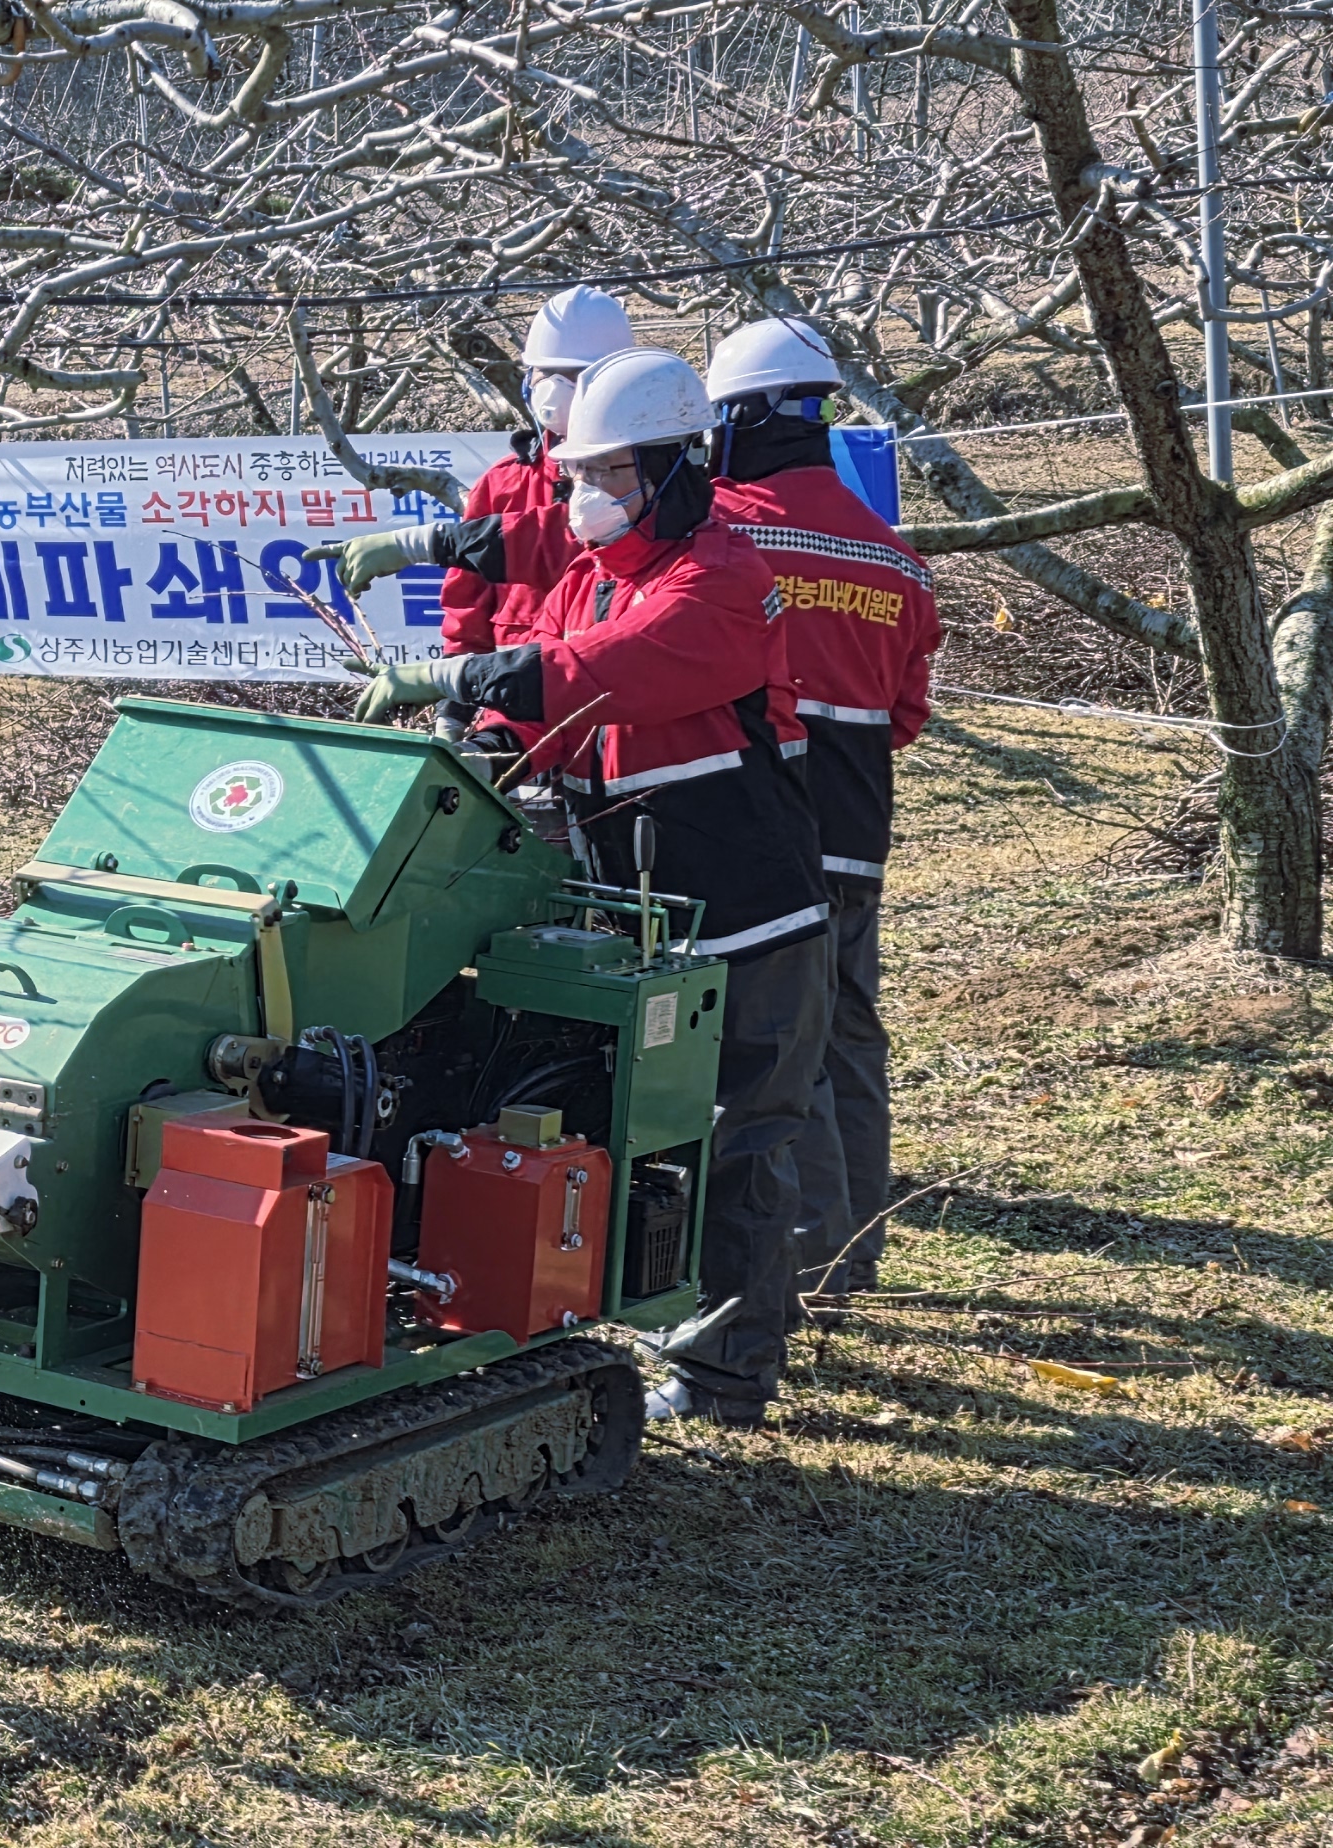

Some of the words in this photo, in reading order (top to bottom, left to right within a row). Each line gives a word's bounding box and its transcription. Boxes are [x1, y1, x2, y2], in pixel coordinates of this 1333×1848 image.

[66, 457, 149, 482] 저력있는
[155, 452, 243, 482] 역사도시
[250, 450, 344, 481] 중흥하는
[141, 490, 285, 527] 소각하지
[300, 488, 378, 526] 말고
